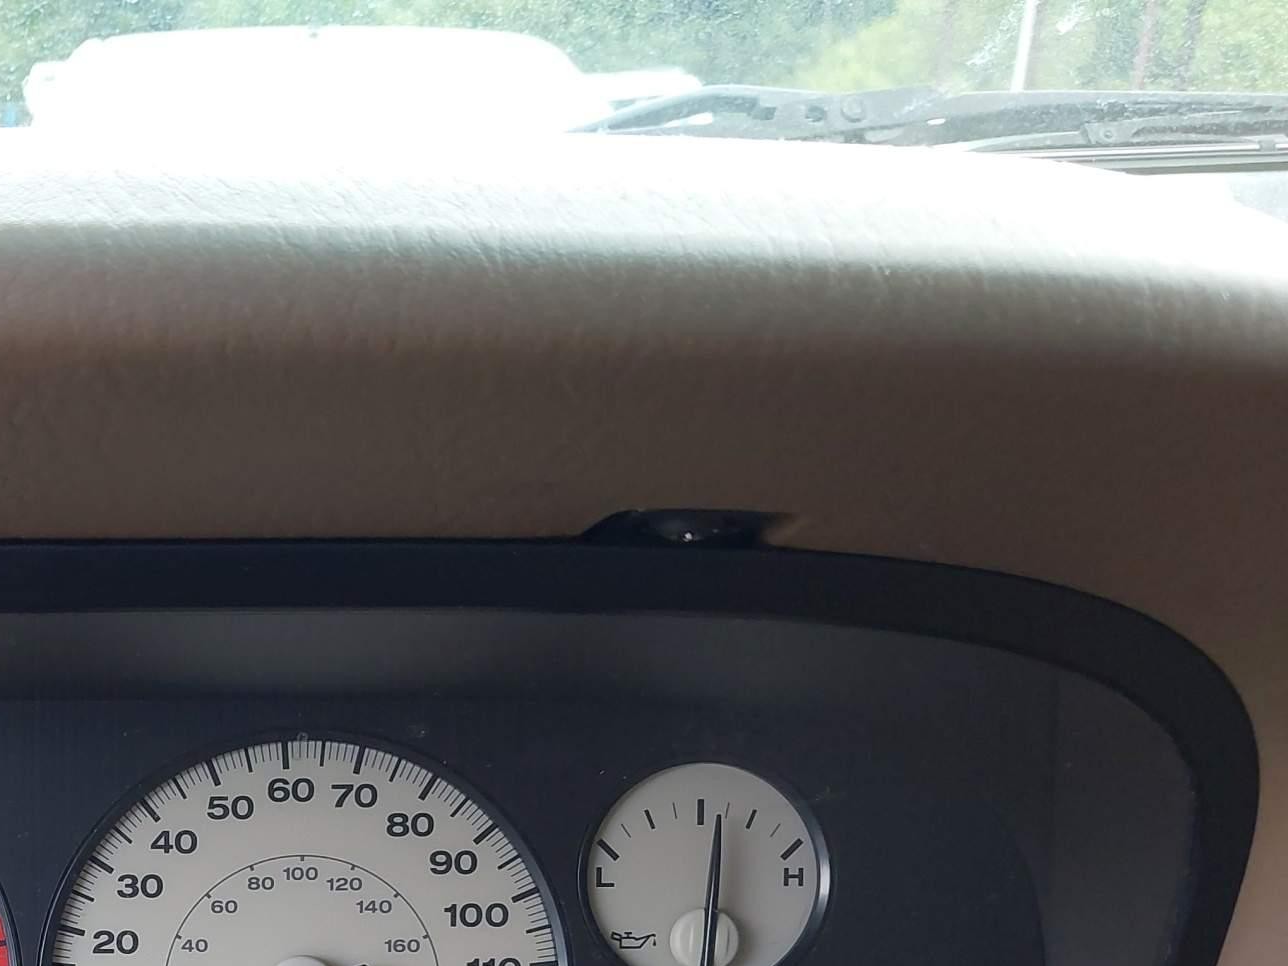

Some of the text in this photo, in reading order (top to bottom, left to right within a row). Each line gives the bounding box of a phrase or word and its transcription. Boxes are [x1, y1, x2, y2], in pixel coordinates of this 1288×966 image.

[267, 777, 315, 803] 60
[331, 783, 378, 808] 70
[206, 795, 254, 820] 50
[386, 812, 435, 838] 80
[150, 829, 198, 855] 40
[282, 866, 319, 881] 100
[429, 850, 478, 875] 90
[116, 873, 164, 899] 30
[247, 876, 275, 891] 80
[326, 877, 363, 891] 120
[596, 867, 615, 887] L
[783, 867, 804, 887] H
[211, 900, 238, 914] 60
[357, 900, 393, 914] 140
[443, 902, 509, 928] 100
[92, 930, 139, 955] 20
[182, 939, 208, 953] 40
[385, 939, 421, 953] 160
